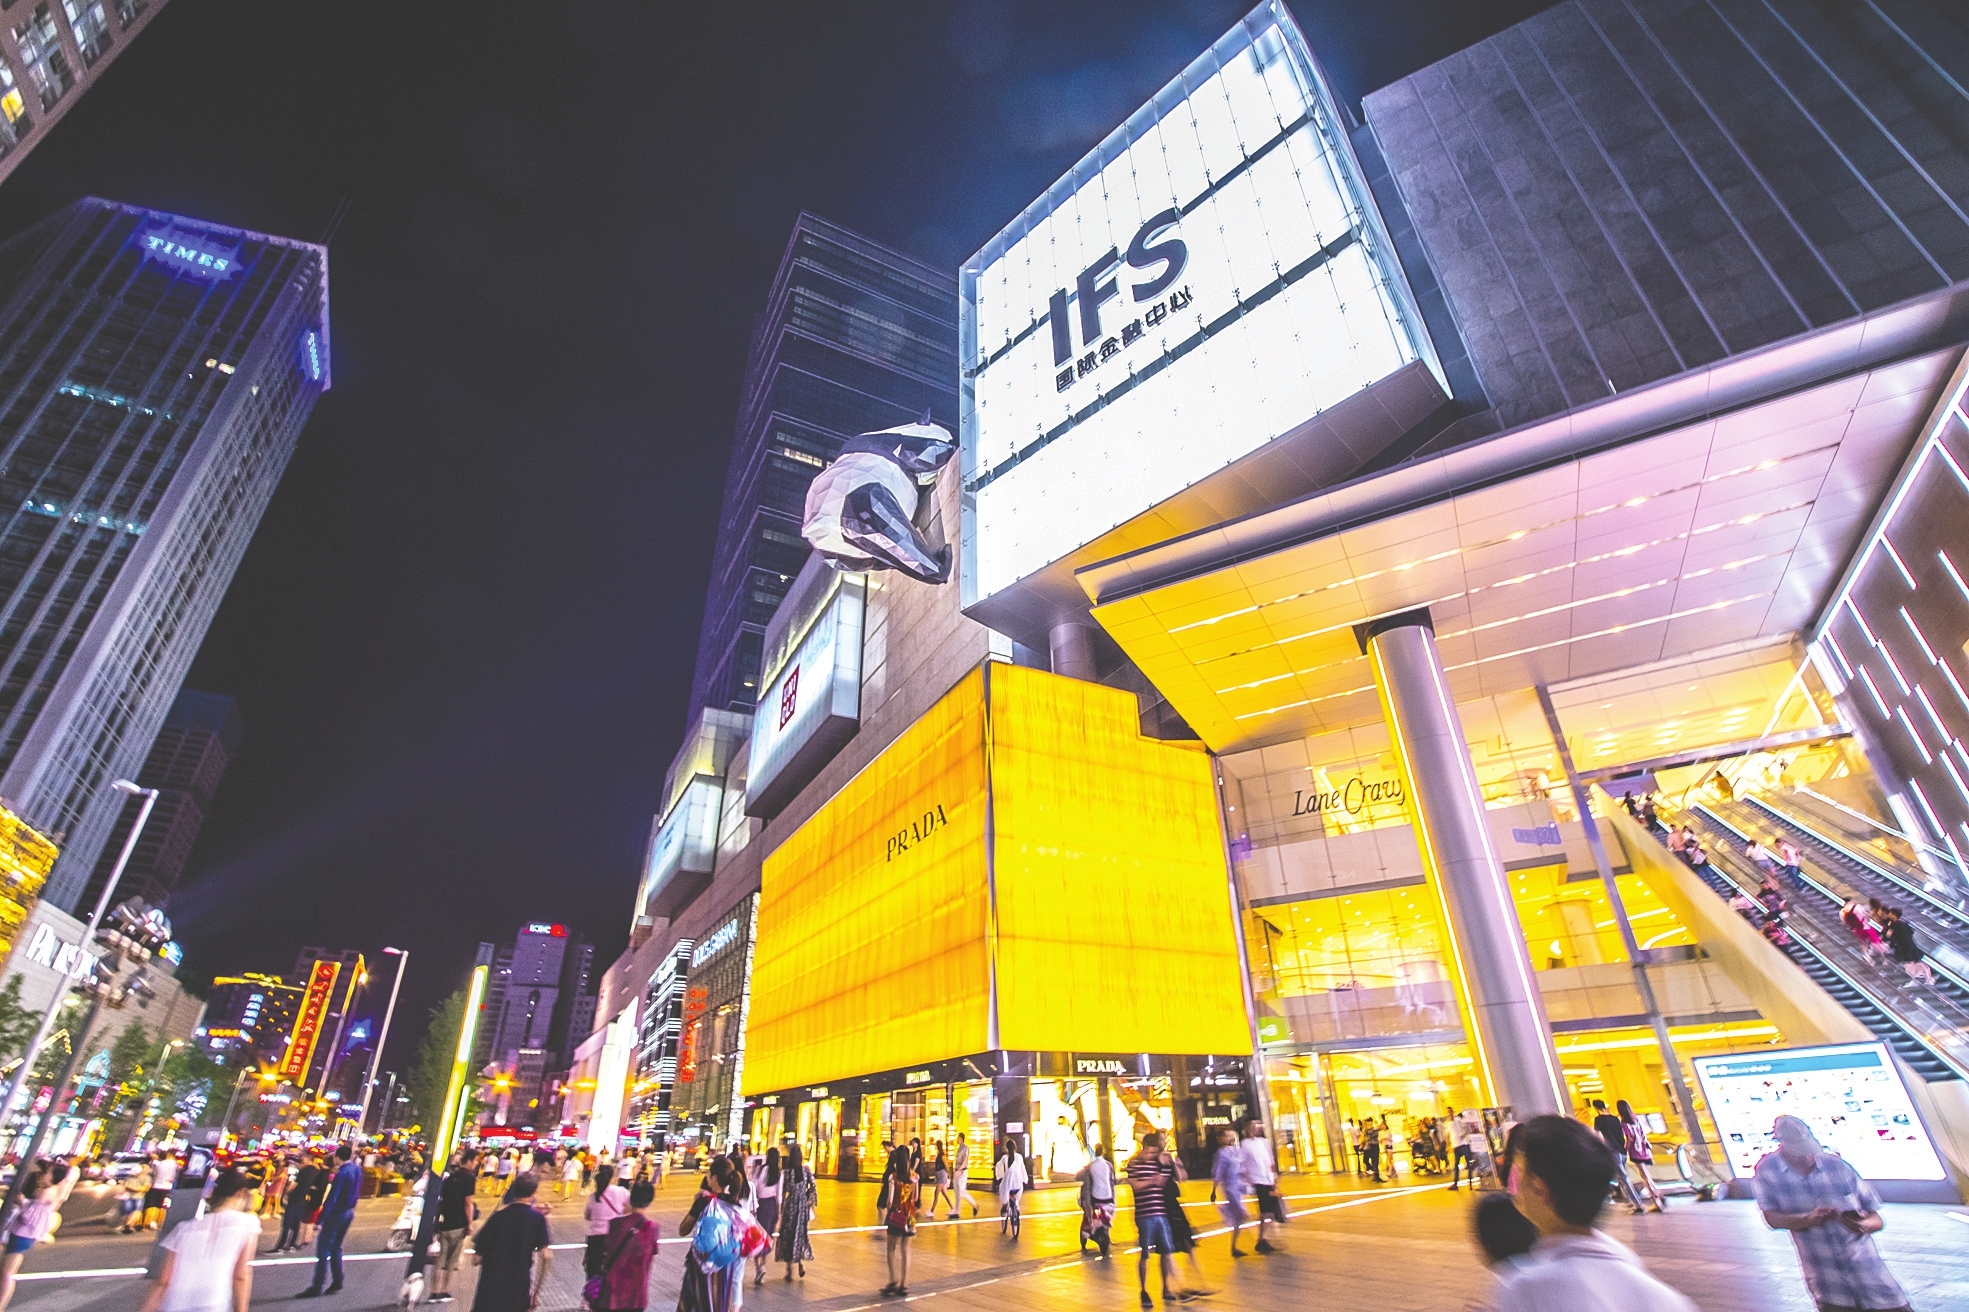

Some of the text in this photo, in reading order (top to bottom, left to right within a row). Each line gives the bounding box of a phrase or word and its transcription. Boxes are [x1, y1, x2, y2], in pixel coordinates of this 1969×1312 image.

[148, 236, 228, 271] TIMES
[1049, 207, 1189, 368] IFS
[1292, 789, 1340, 816] Lane
[886, 804, 948, 863] PRADA
[24, 922, 101, 987] PAKSON
[1077, 1059, 1126, 1073] PRADA
